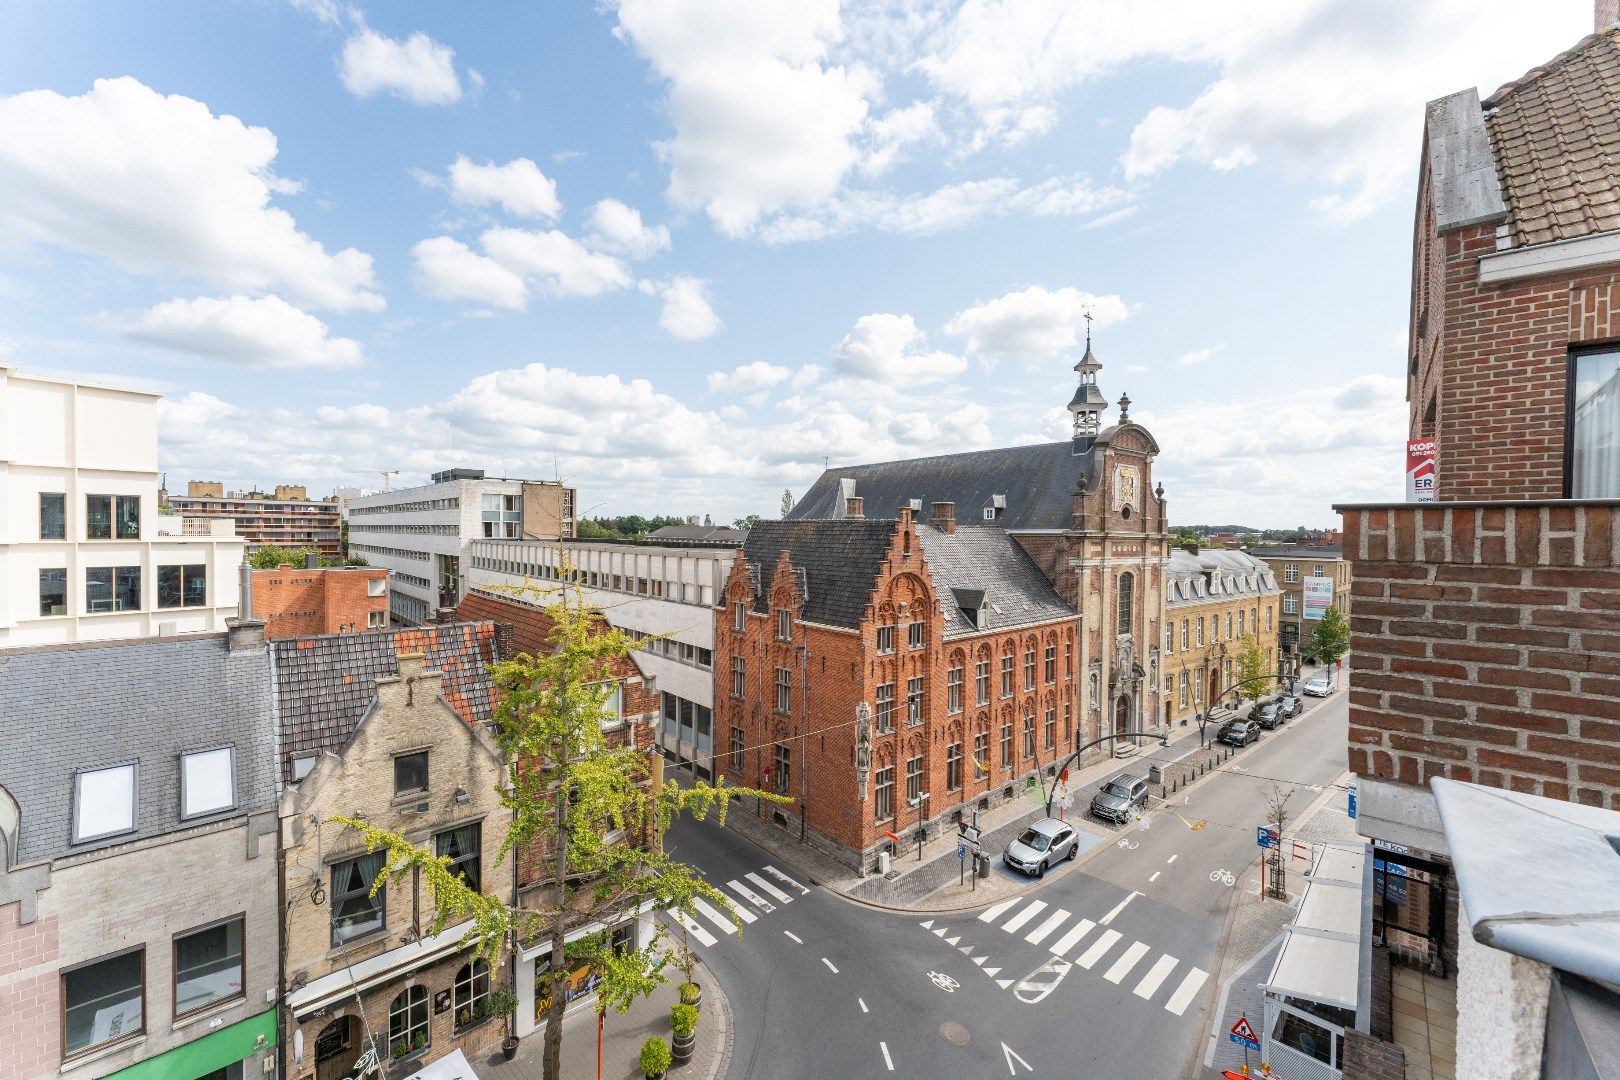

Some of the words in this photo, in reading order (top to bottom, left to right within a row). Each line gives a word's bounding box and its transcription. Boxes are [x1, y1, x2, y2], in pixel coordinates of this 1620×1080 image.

[1415, 479, 1434, 488] ER
[1258, 829, 1268, 840] P
[1234, 1036, 1246, 1046] 50
